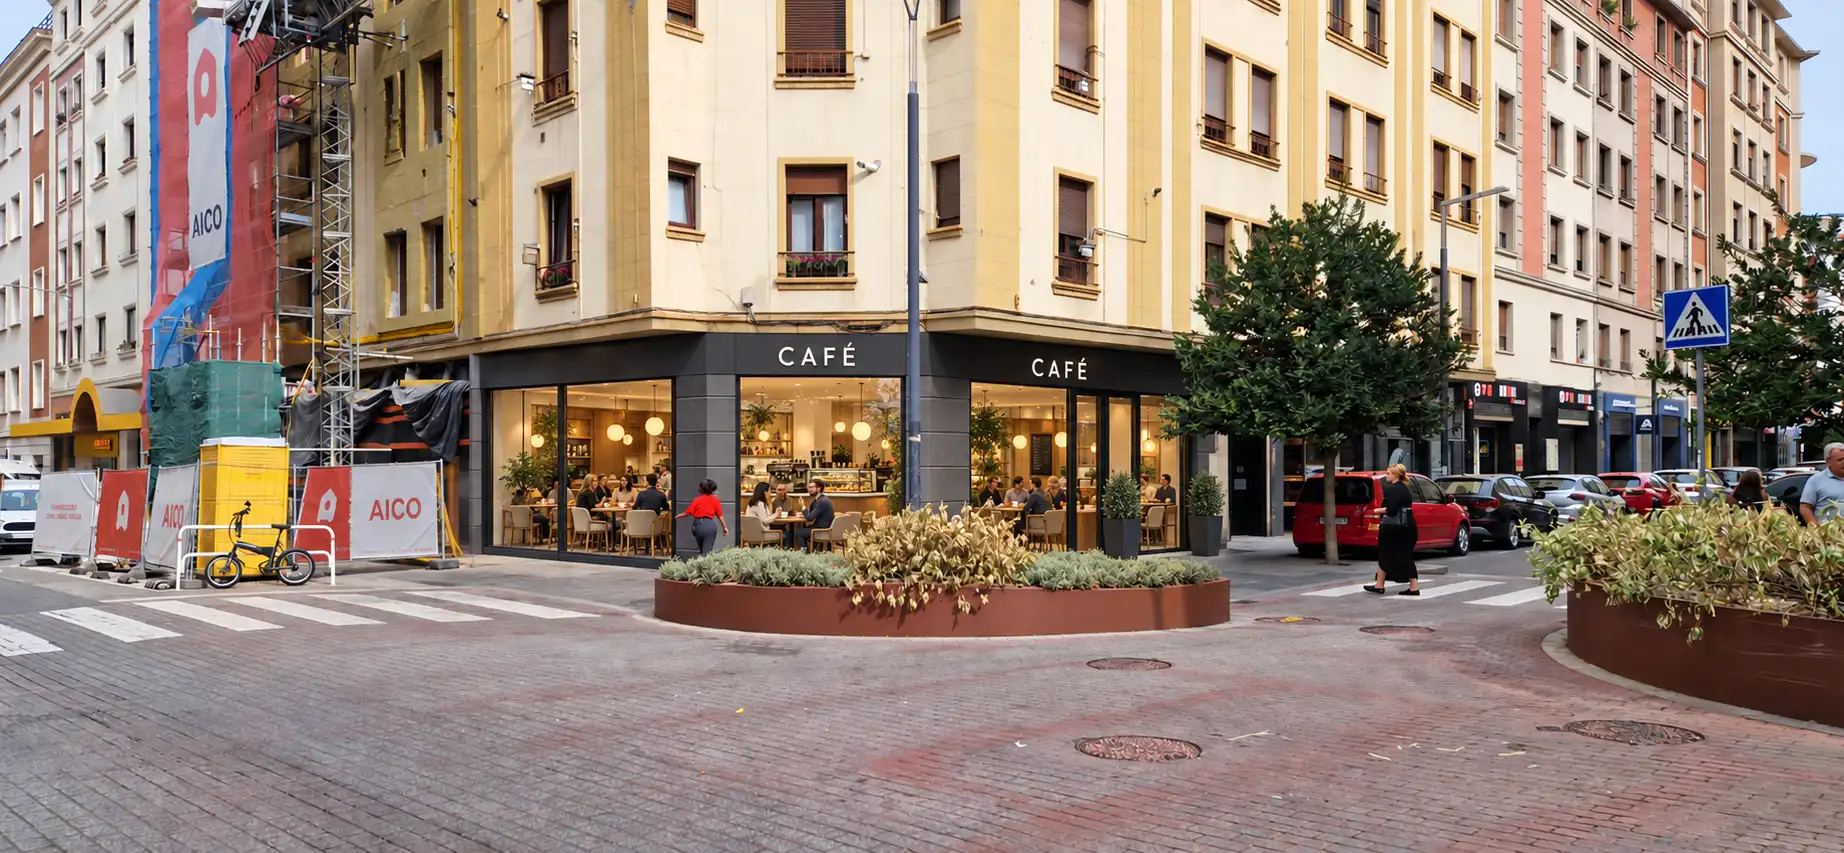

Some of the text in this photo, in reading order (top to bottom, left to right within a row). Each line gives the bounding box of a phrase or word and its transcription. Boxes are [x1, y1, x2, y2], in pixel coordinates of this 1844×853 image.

[192, 204, 222, 239] AICO
[778, 342, 856, 366] CAFÉ
[1031, 357, 1087, 380] CAFÉ
[161, 504, 185, 528] AICO
[369, 497, 422, 521] AICO
